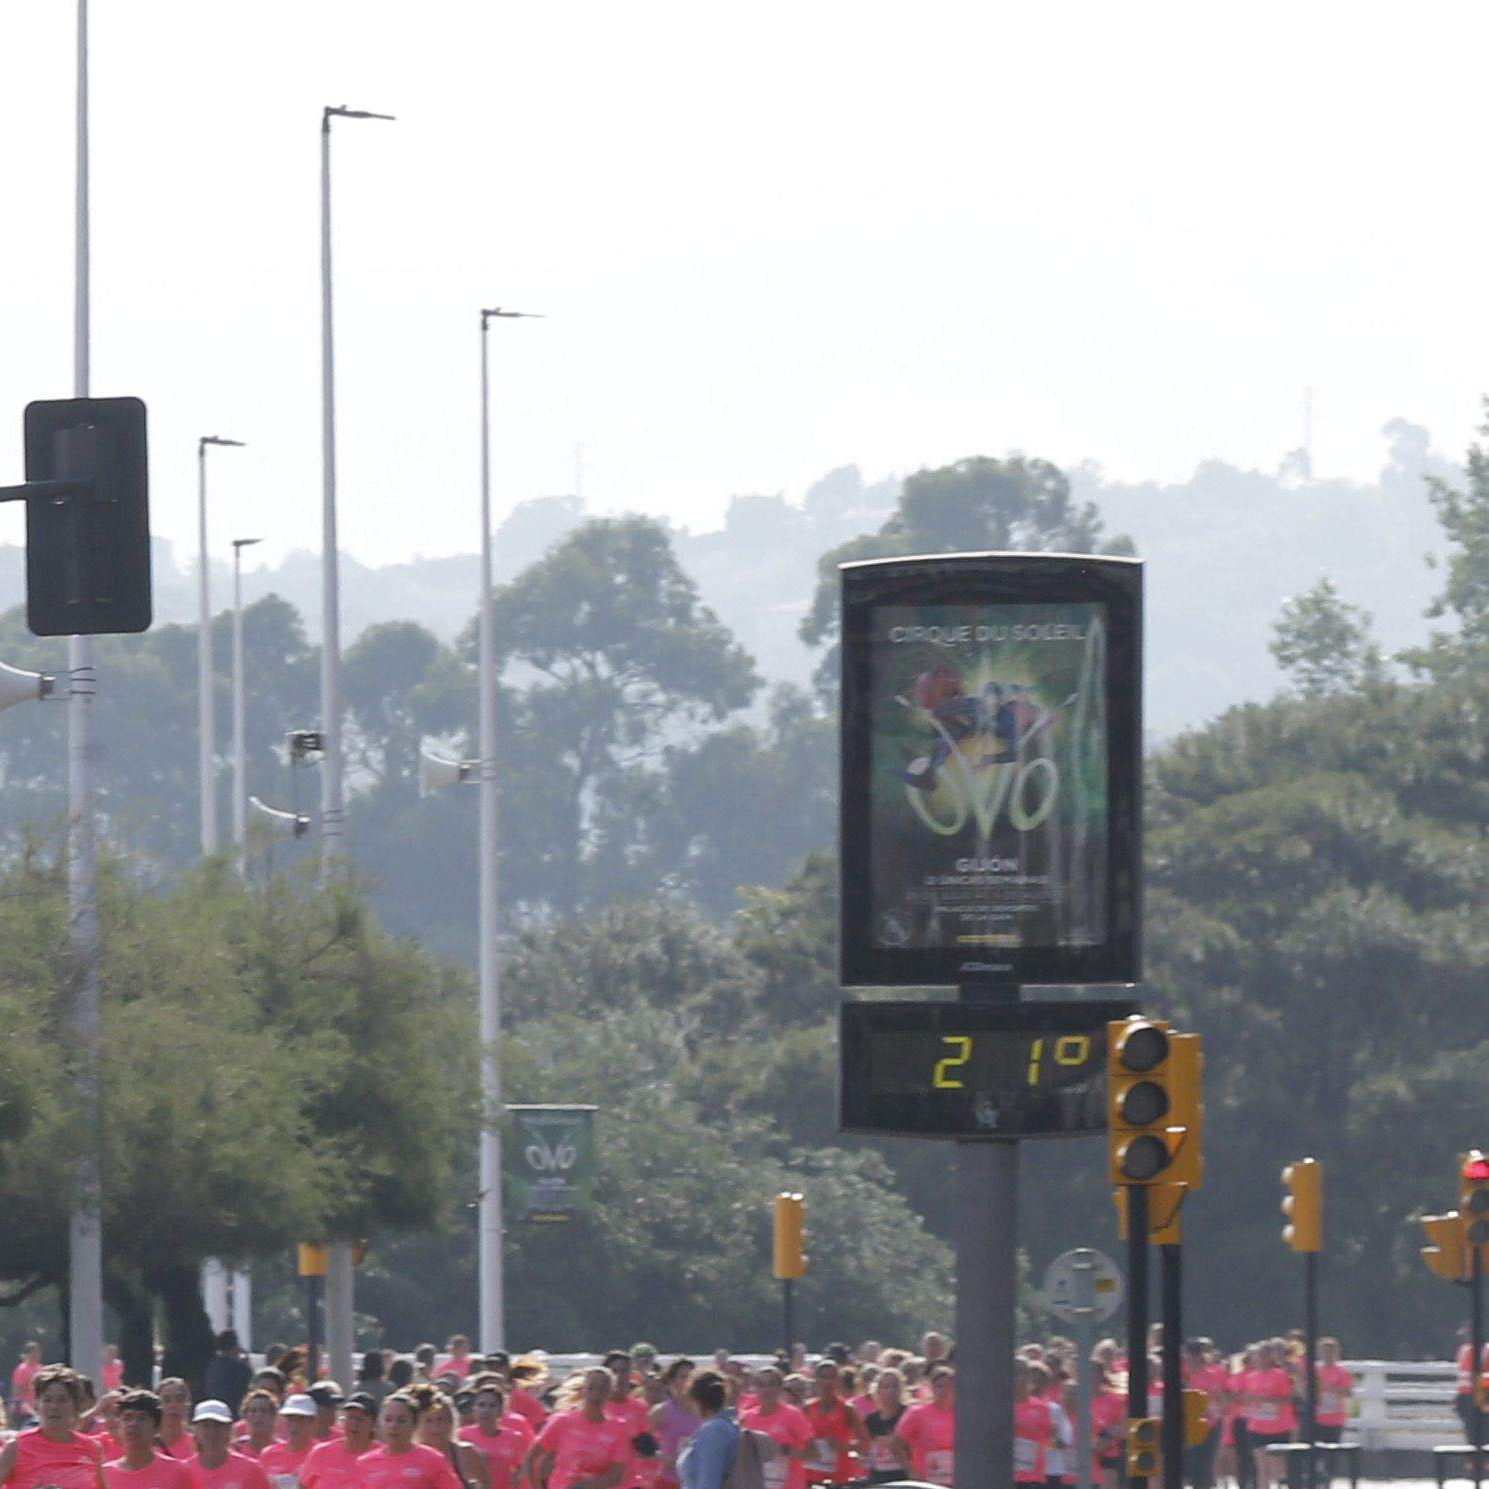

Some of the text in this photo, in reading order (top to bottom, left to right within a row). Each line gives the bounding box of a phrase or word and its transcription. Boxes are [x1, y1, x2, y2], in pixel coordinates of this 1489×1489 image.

[889, 624, 1087, 647] CIRQUE DU SOLEIL
[899, 718, 1069, 841] OVO
